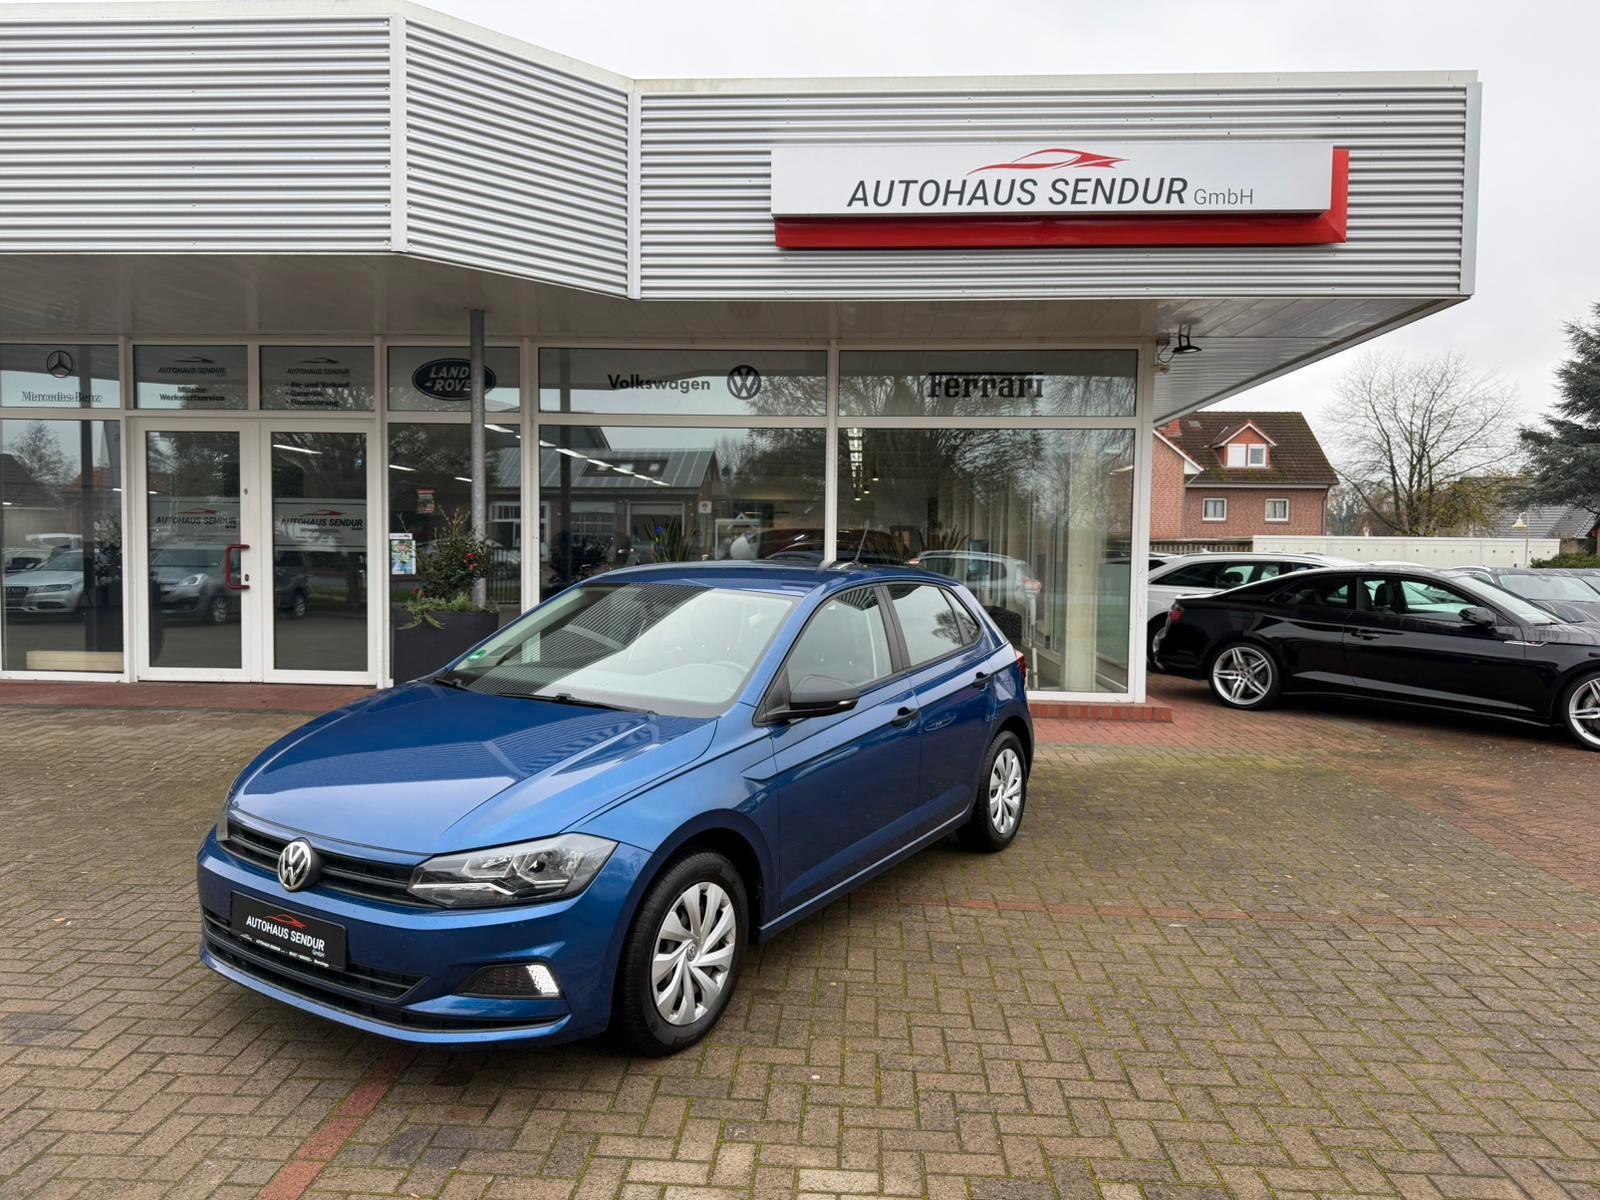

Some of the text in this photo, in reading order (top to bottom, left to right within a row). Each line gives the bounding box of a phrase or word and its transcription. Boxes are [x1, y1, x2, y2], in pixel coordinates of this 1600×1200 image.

[846, 177, 1254, 207] AUTOHAUS SENDUR GmbH
[430, 366, 470, 378] LAND
[607, 373, 711, 394] Volkswagen
[927, 371, 1045, 399] Ferrari
[21, 390, 104, 403] Mercedes-Benz
[156, 516, 237, 526] AUTOHAUS SENDUR
[280, 517, 364, 527] AUTOHAUS SENDUR
[246, 915, 289, 939] AUTOHAUS
[290, 930, 325, 951] SENDUR
